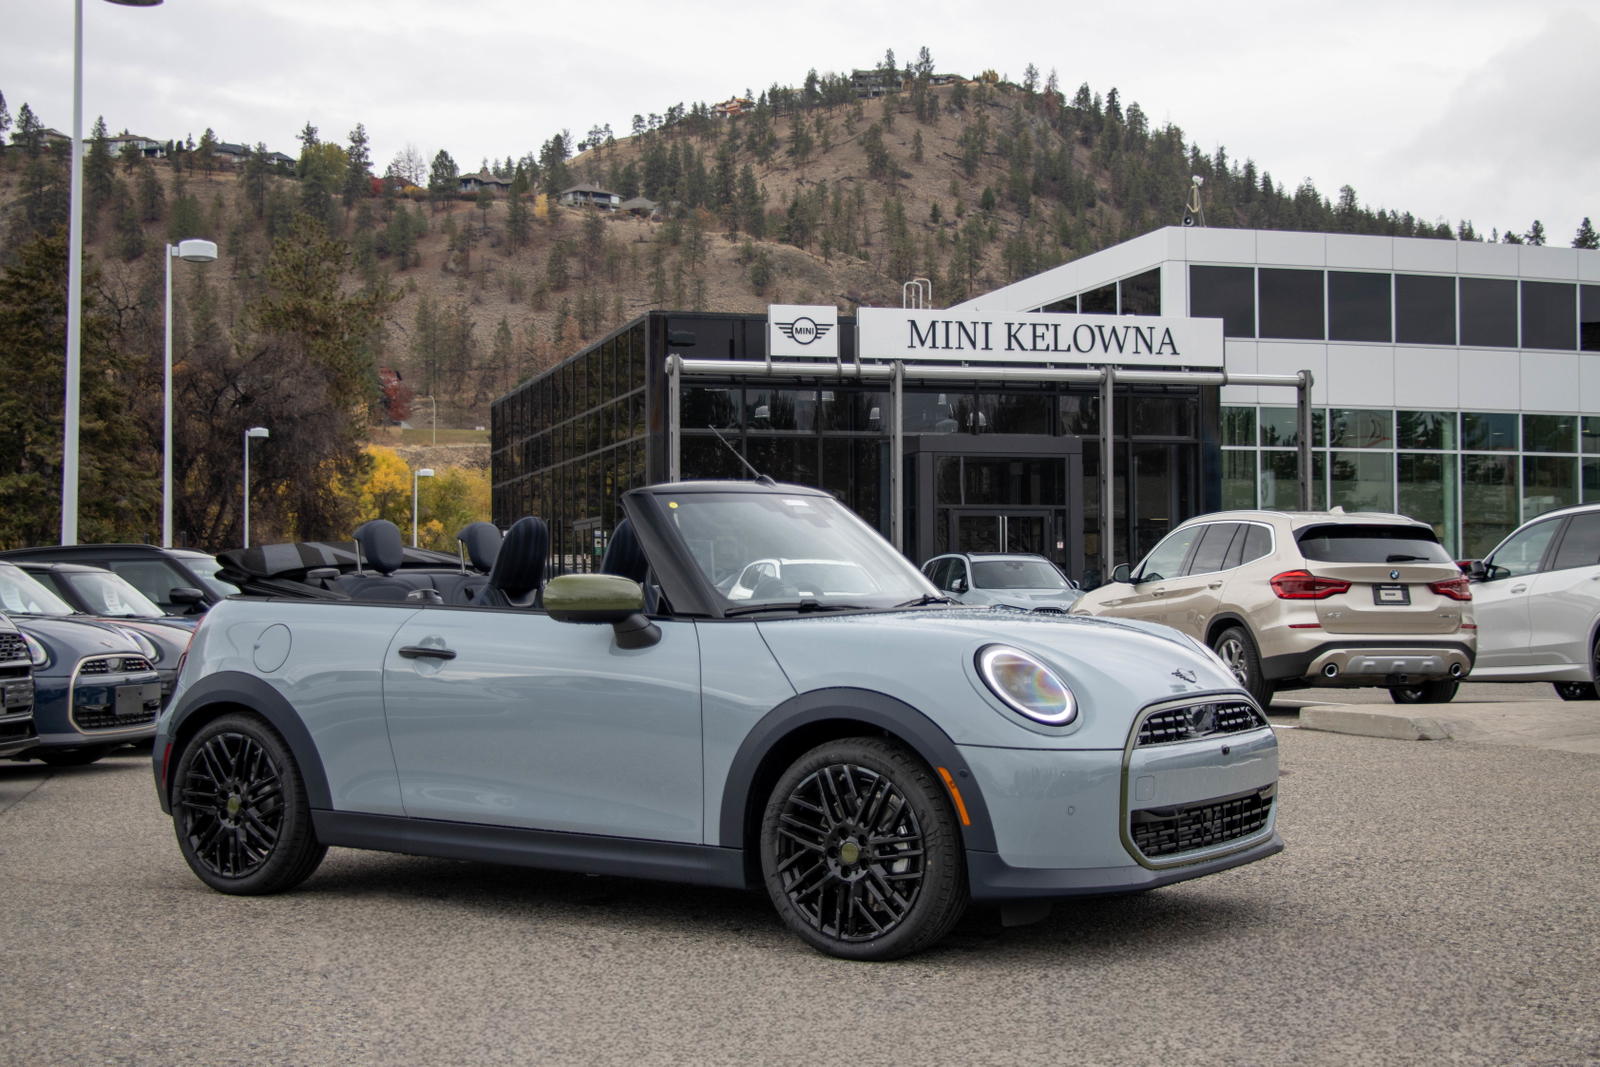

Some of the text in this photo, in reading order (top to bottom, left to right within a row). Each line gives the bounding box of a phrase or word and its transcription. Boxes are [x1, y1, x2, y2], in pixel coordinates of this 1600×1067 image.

[794, 326, 815, 335] MINI
[907, 319, 1180, 356] MINI KELOWNA
